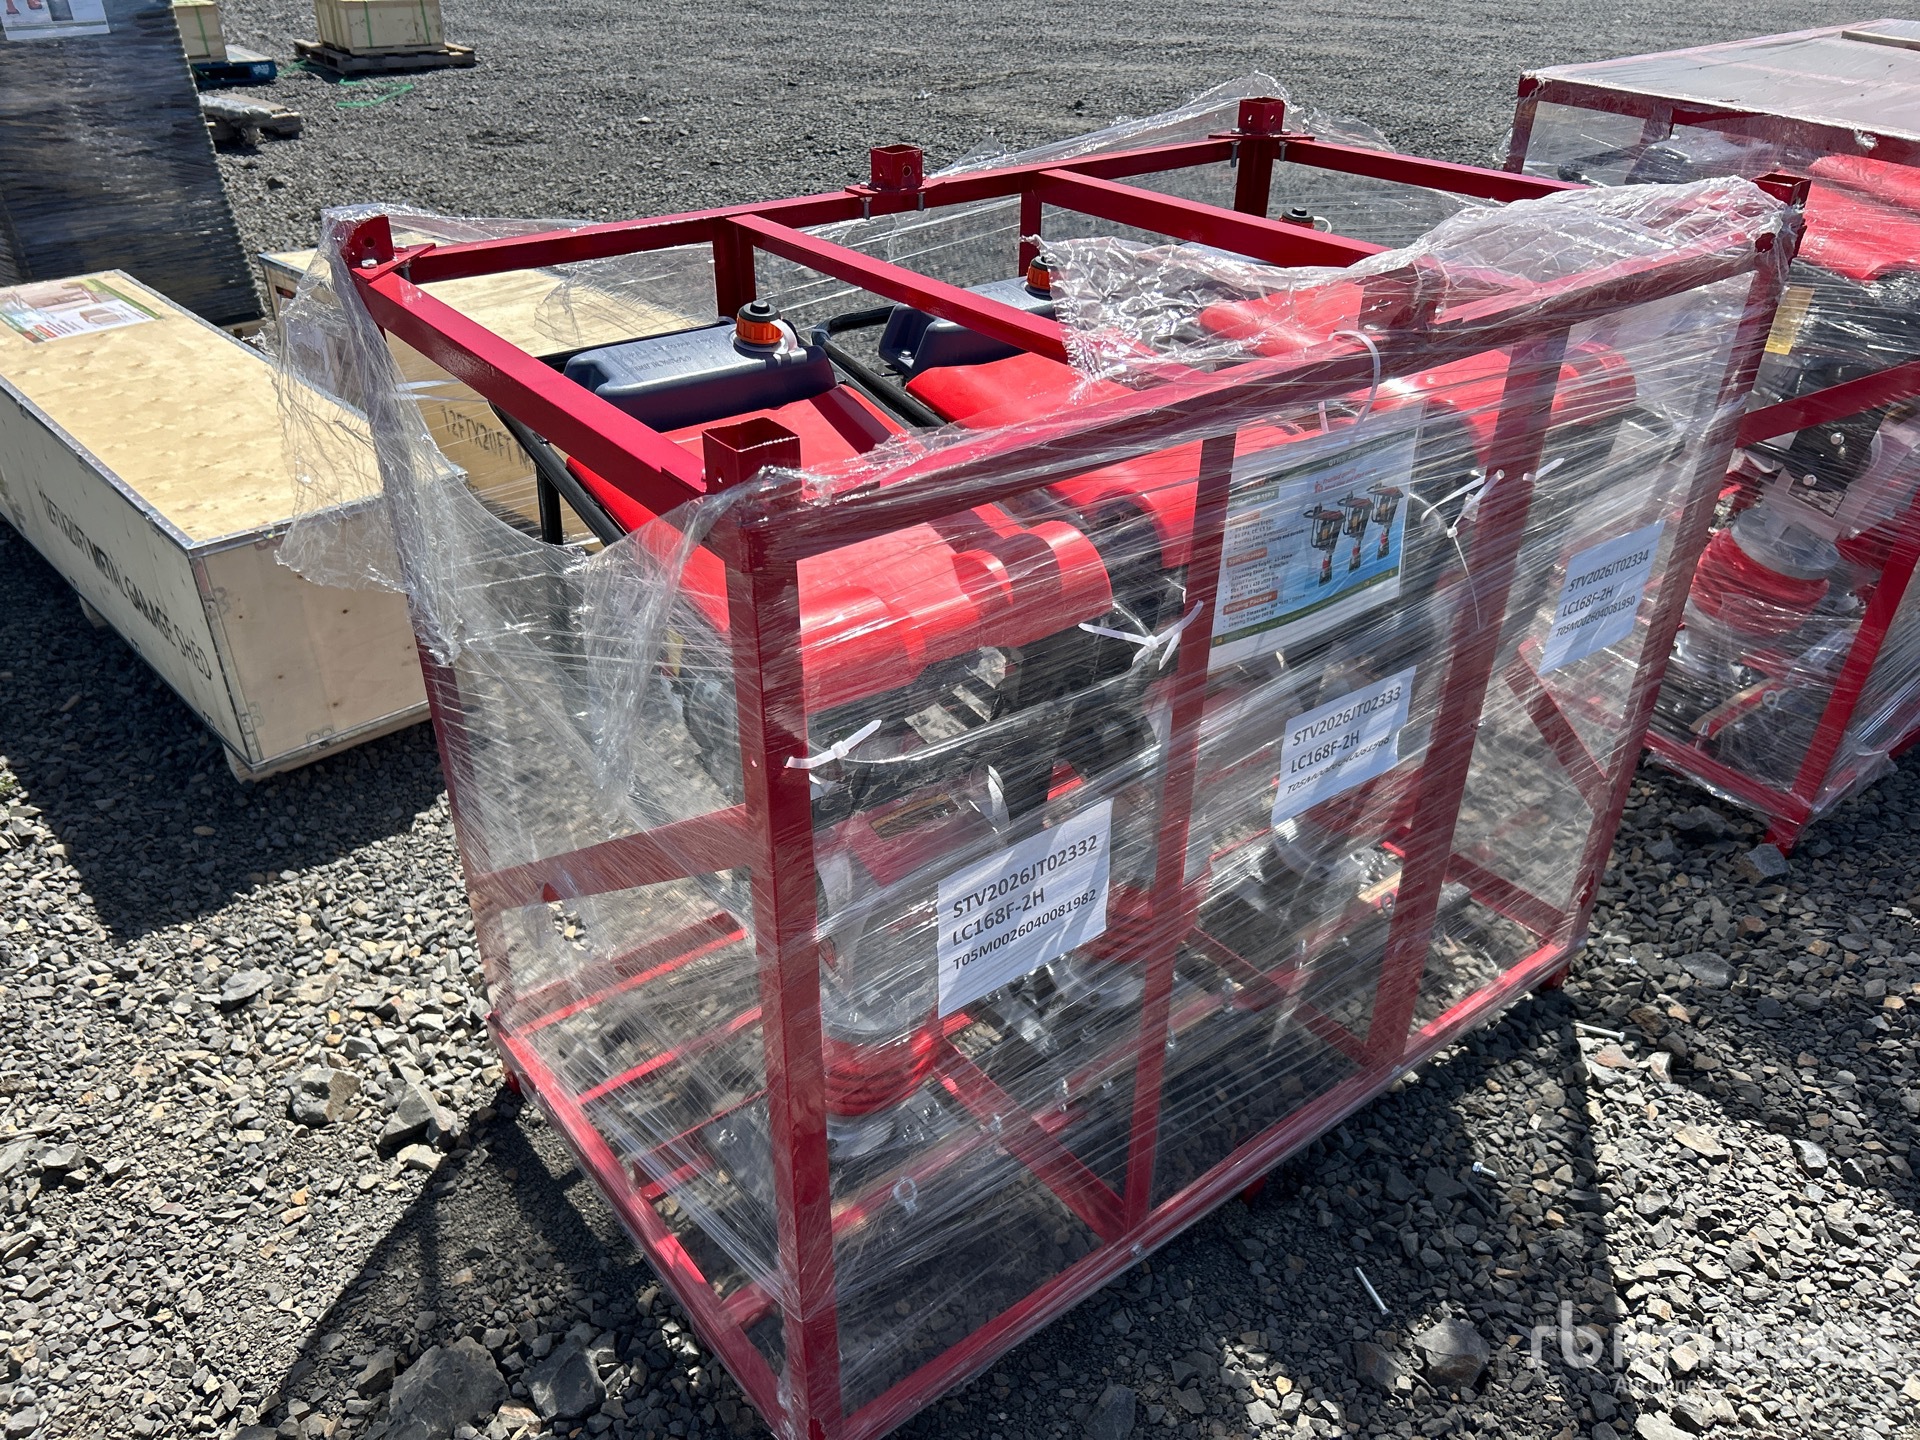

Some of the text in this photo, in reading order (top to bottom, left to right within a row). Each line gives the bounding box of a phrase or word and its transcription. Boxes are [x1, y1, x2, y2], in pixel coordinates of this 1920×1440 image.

[1568, 550, 1650, 592] STV2026JT02334
[125, 576, 176, 648] GARAGE
[173, 624, 212, 681] SHED
[1562, 585, 1614, 617] LC168F-2H
[1292, 687, 1402, 747] STV2026JT02333
[1290, 730, 1360, 774] LC168F-2H
[953, 834, 1098, 919] STV2026JT02332
[952, 888, 1097, 970] T05M0026040081982
[953, 887, 1045, 946] LC168F-2H
